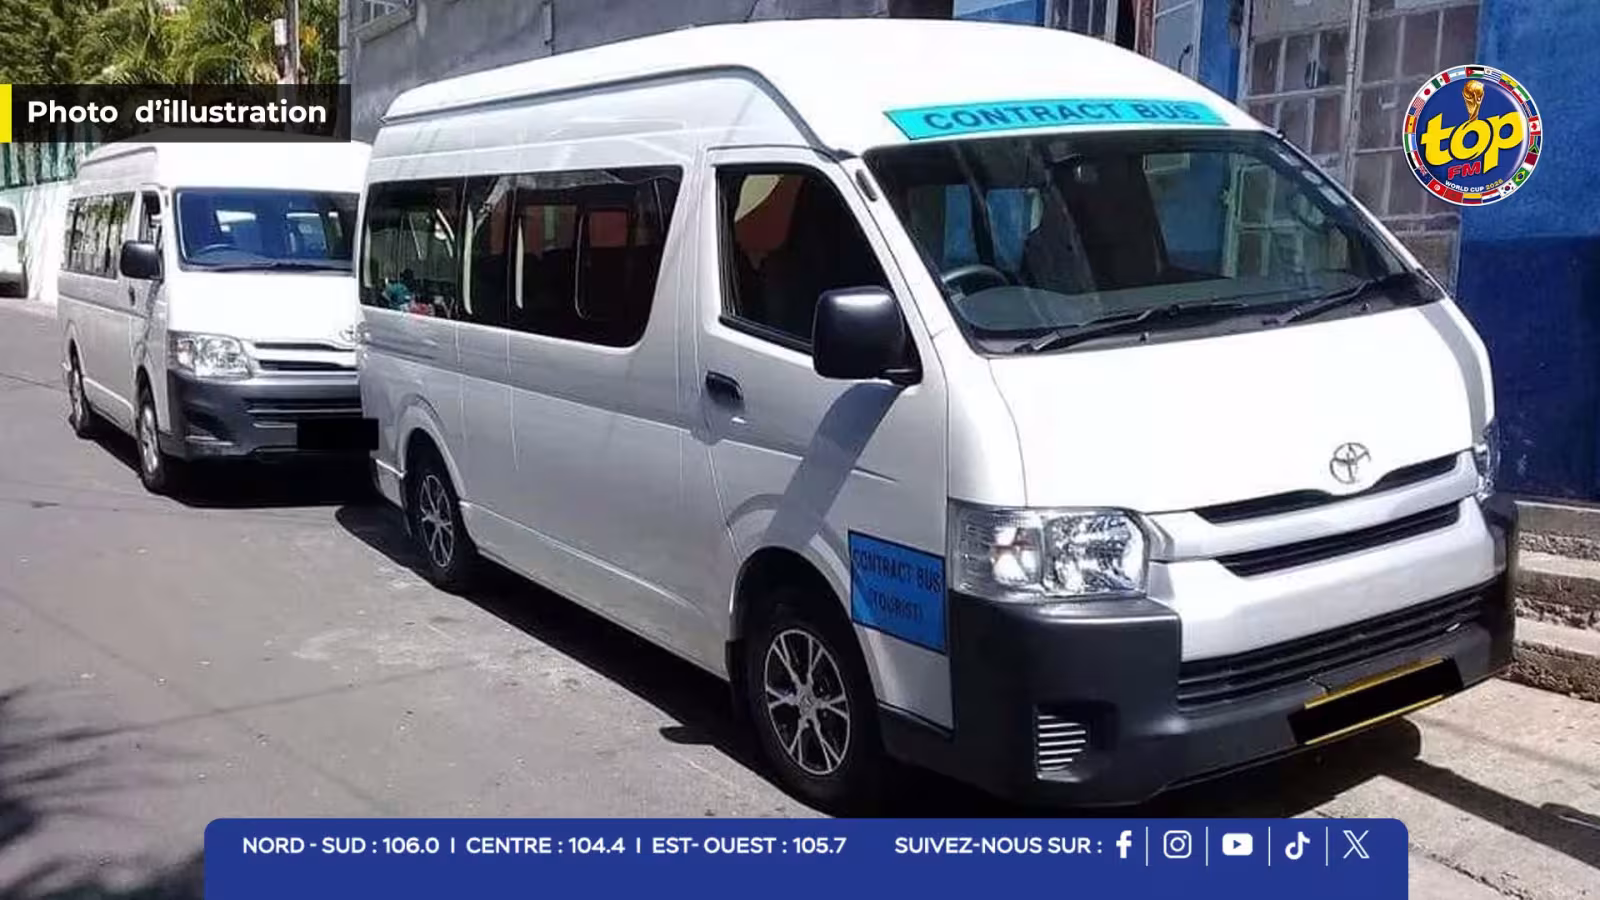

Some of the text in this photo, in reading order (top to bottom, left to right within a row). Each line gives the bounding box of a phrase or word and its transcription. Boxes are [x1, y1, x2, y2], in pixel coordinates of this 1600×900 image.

[923, 103, 1200, 130] CONTRACT BUS
[853, 550, 943, 593] CONTRACT BUS
